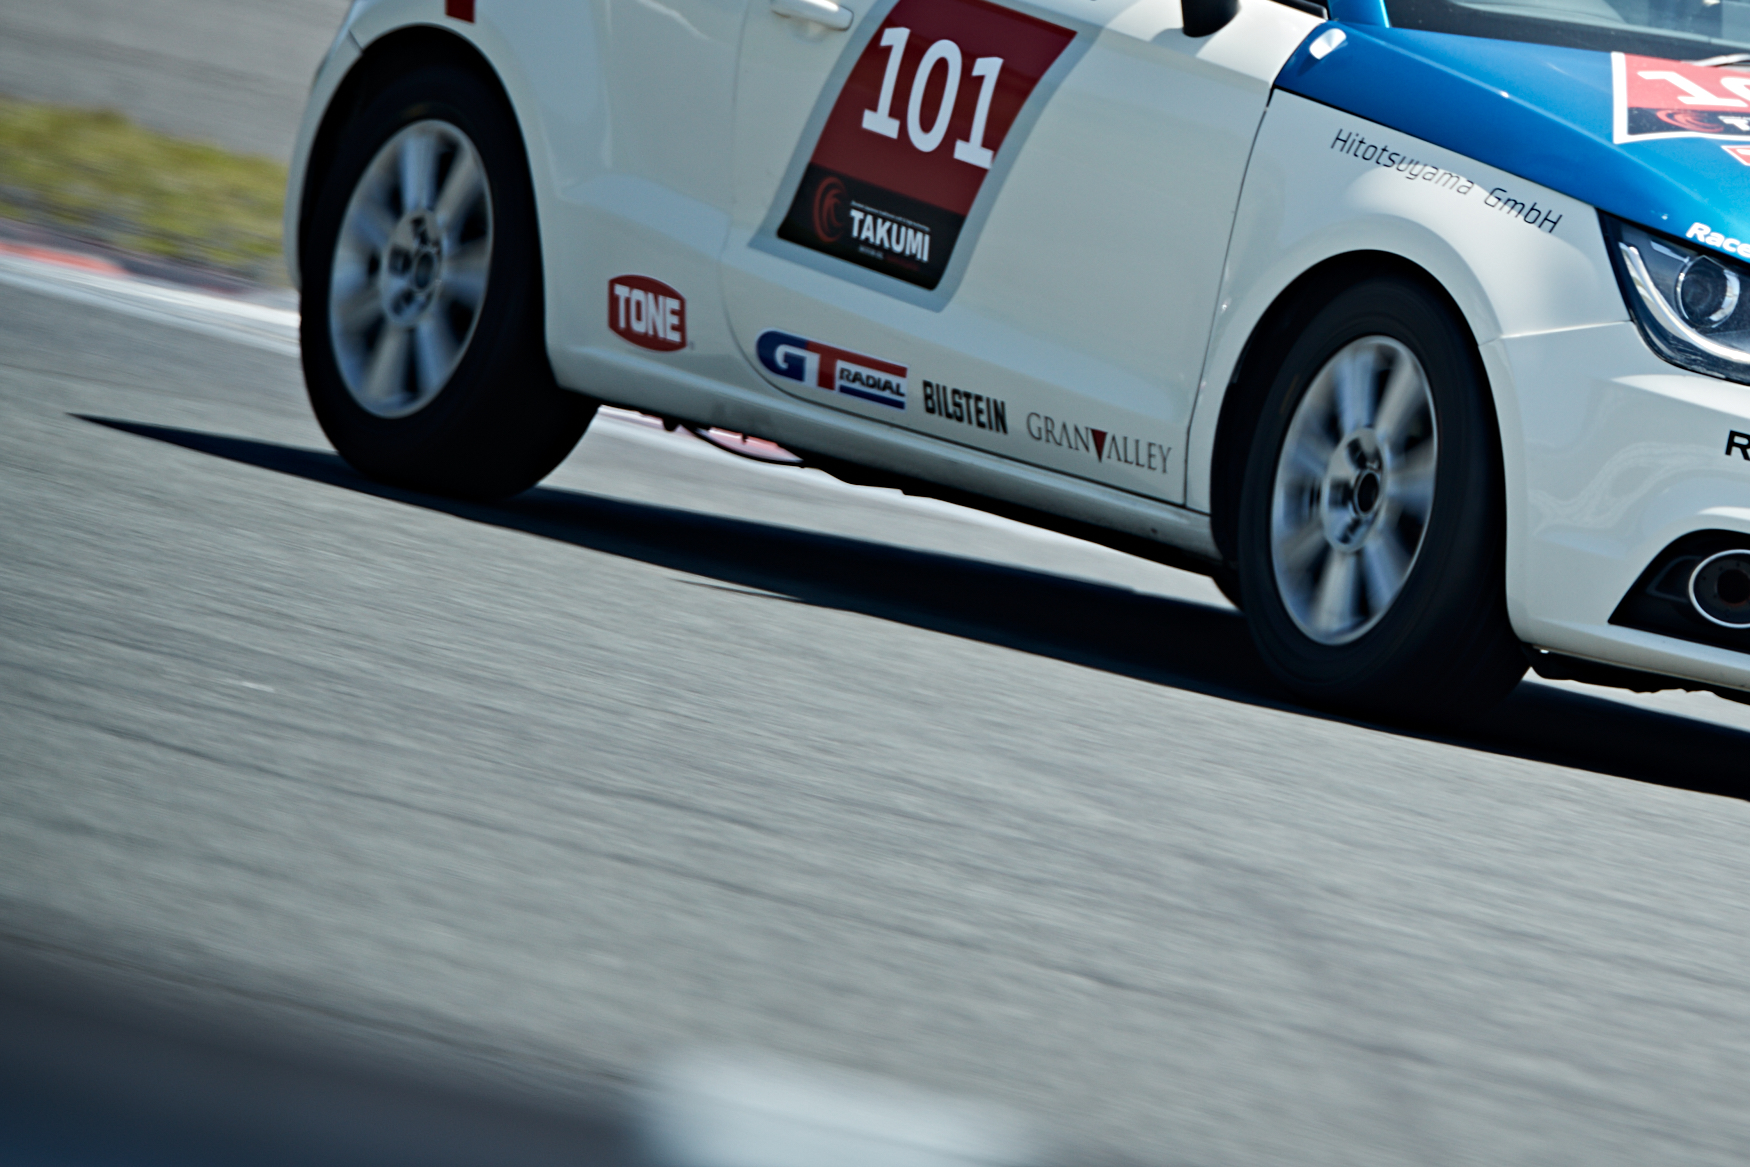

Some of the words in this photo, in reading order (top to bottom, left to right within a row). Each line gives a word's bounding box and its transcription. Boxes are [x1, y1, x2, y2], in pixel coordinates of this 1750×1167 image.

[861, 26, 1004, 170] 101
[1330, 128, 1475, 196] Hitotsuyama
[1483, 187, 1564, 235] GmbH
[849, 208, 930, 263] TAKUMI
[613, 282, 682, 342] TONE
[756, 330, 909, 392] GT
[838, 366, 906, 397] RADIAL
[922, 379, 1008, 435] BILSTEIN
